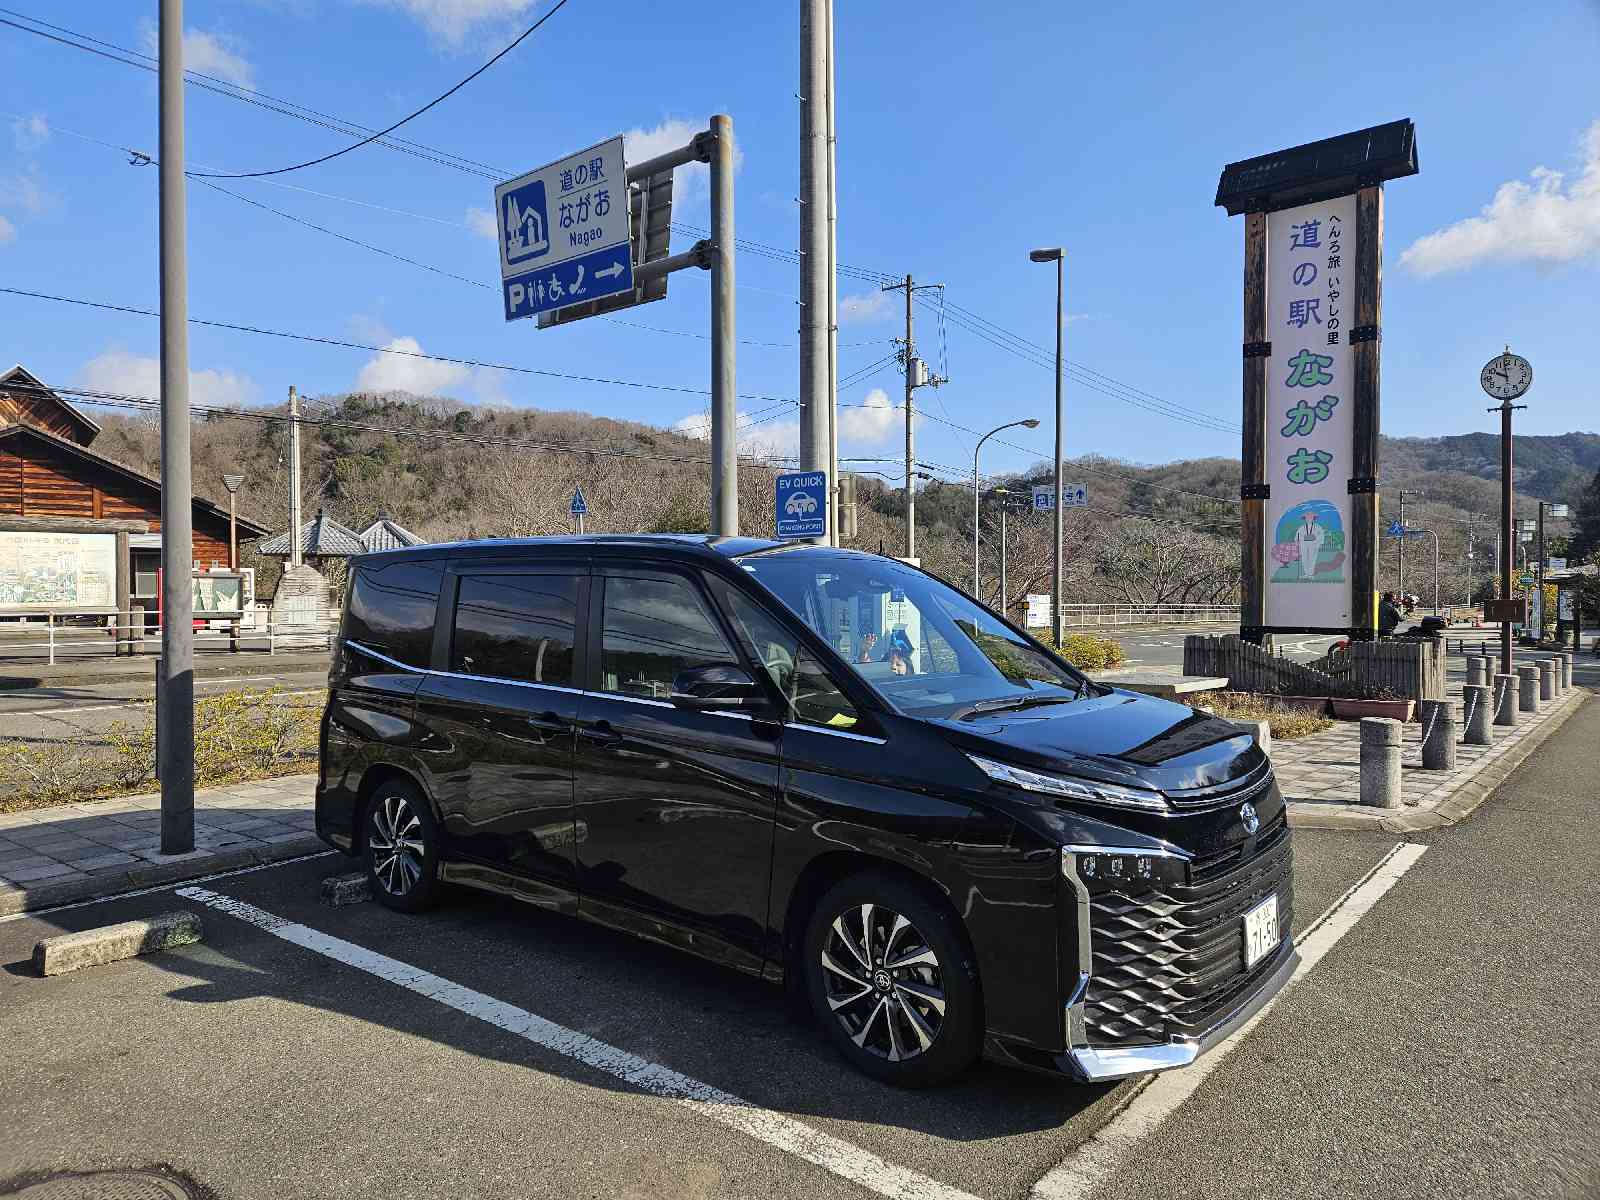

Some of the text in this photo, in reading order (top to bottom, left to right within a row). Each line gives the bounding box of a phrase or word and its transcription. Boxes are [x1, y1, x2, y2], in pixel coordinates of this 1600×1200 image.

[559, 157, 605, 193] 道の駅
[559, 189, 610, 229] ながお
[569, 227, 603, 247] Nagao
[1287, 218, 1322, 329] 道の駅
[1327, 215, 1342, 346] へんろ旅 いやしの里
[508, 283, 525, 312] P
[1280, 349, 1339, 484] ながお
[779, 475, 823, 489] EV QUICK
